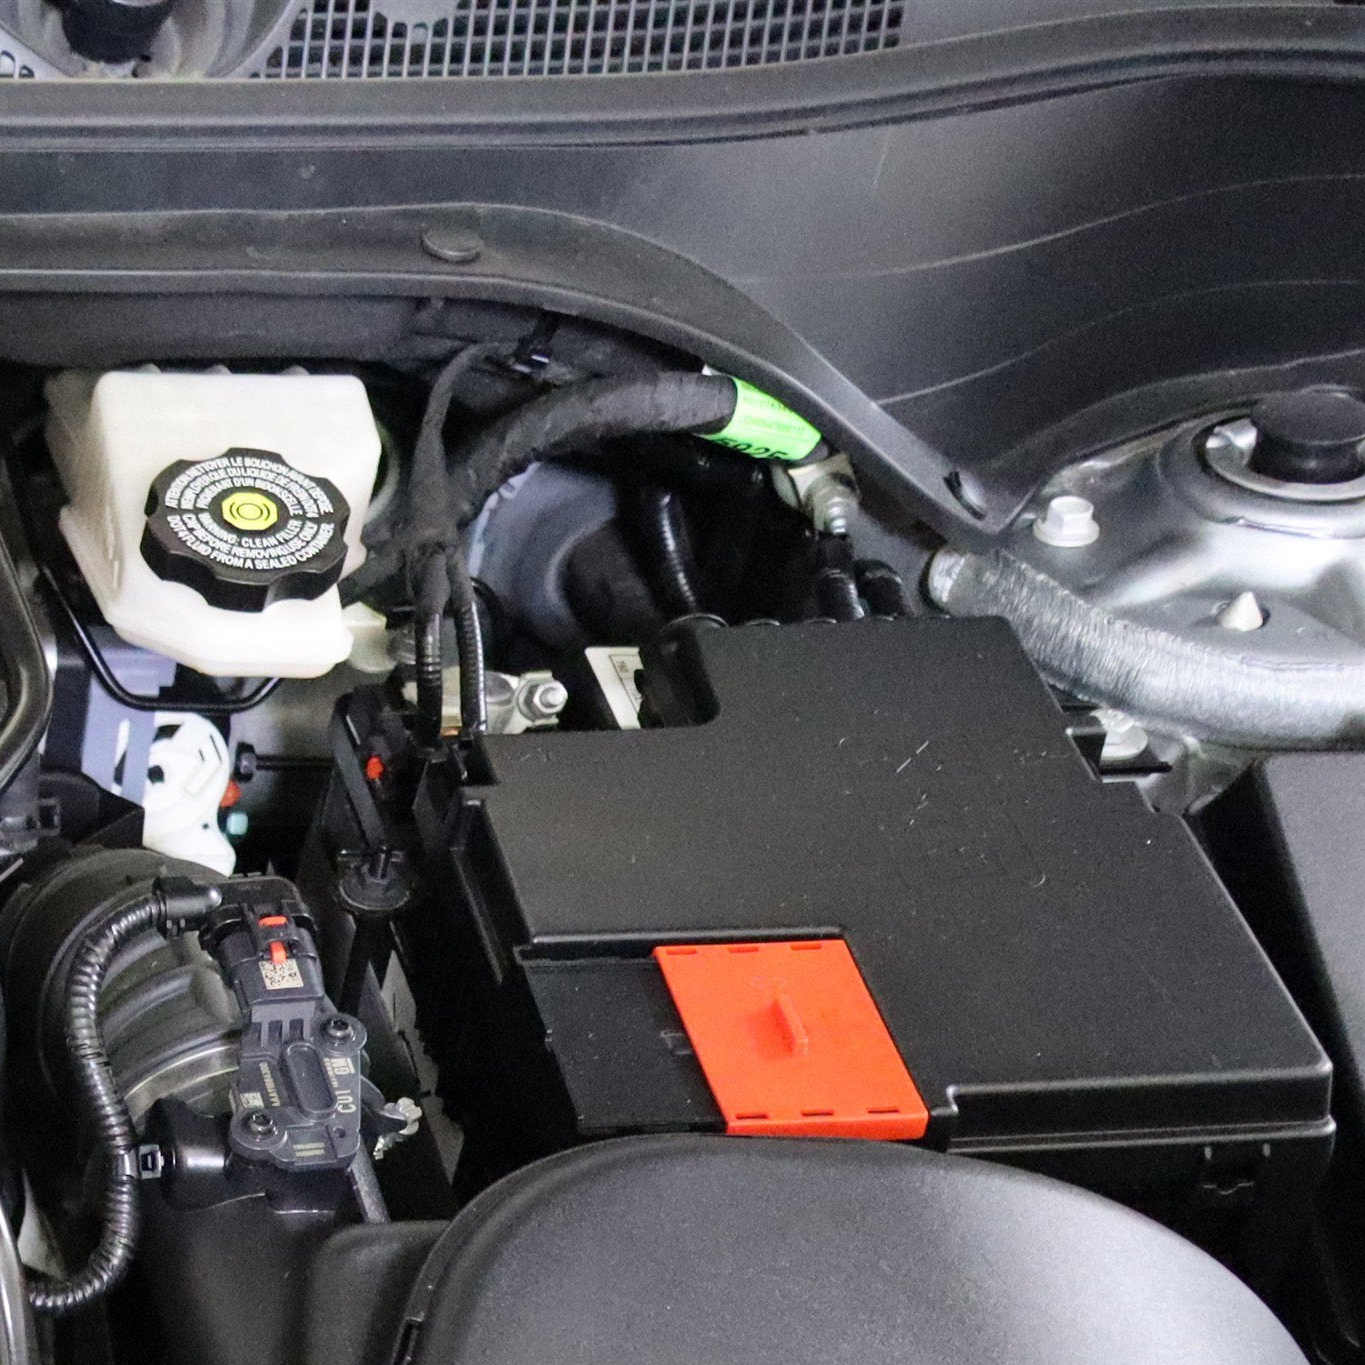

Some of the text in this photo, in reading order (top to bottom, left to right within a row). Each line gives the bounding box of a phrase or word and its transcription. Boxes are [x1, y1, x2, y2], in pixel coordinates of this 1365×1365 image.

[229, 455, 243, 466] LE
[226, 466, 241, 477] DU
[181, 514, 201, 532] CAP
[297, 521, 319, 541] ONLY
[190, 528, 232, 555] BEFORE
[241, 535, 280, 549] CLEAN
[274, 518, 303, 543] FILLER
[180, 534, 211, 557] FLUID
[208, 550, 243, 566] FROM
[244, 558, 253, 568] A
[255, 552, 298, 571] SEALED
